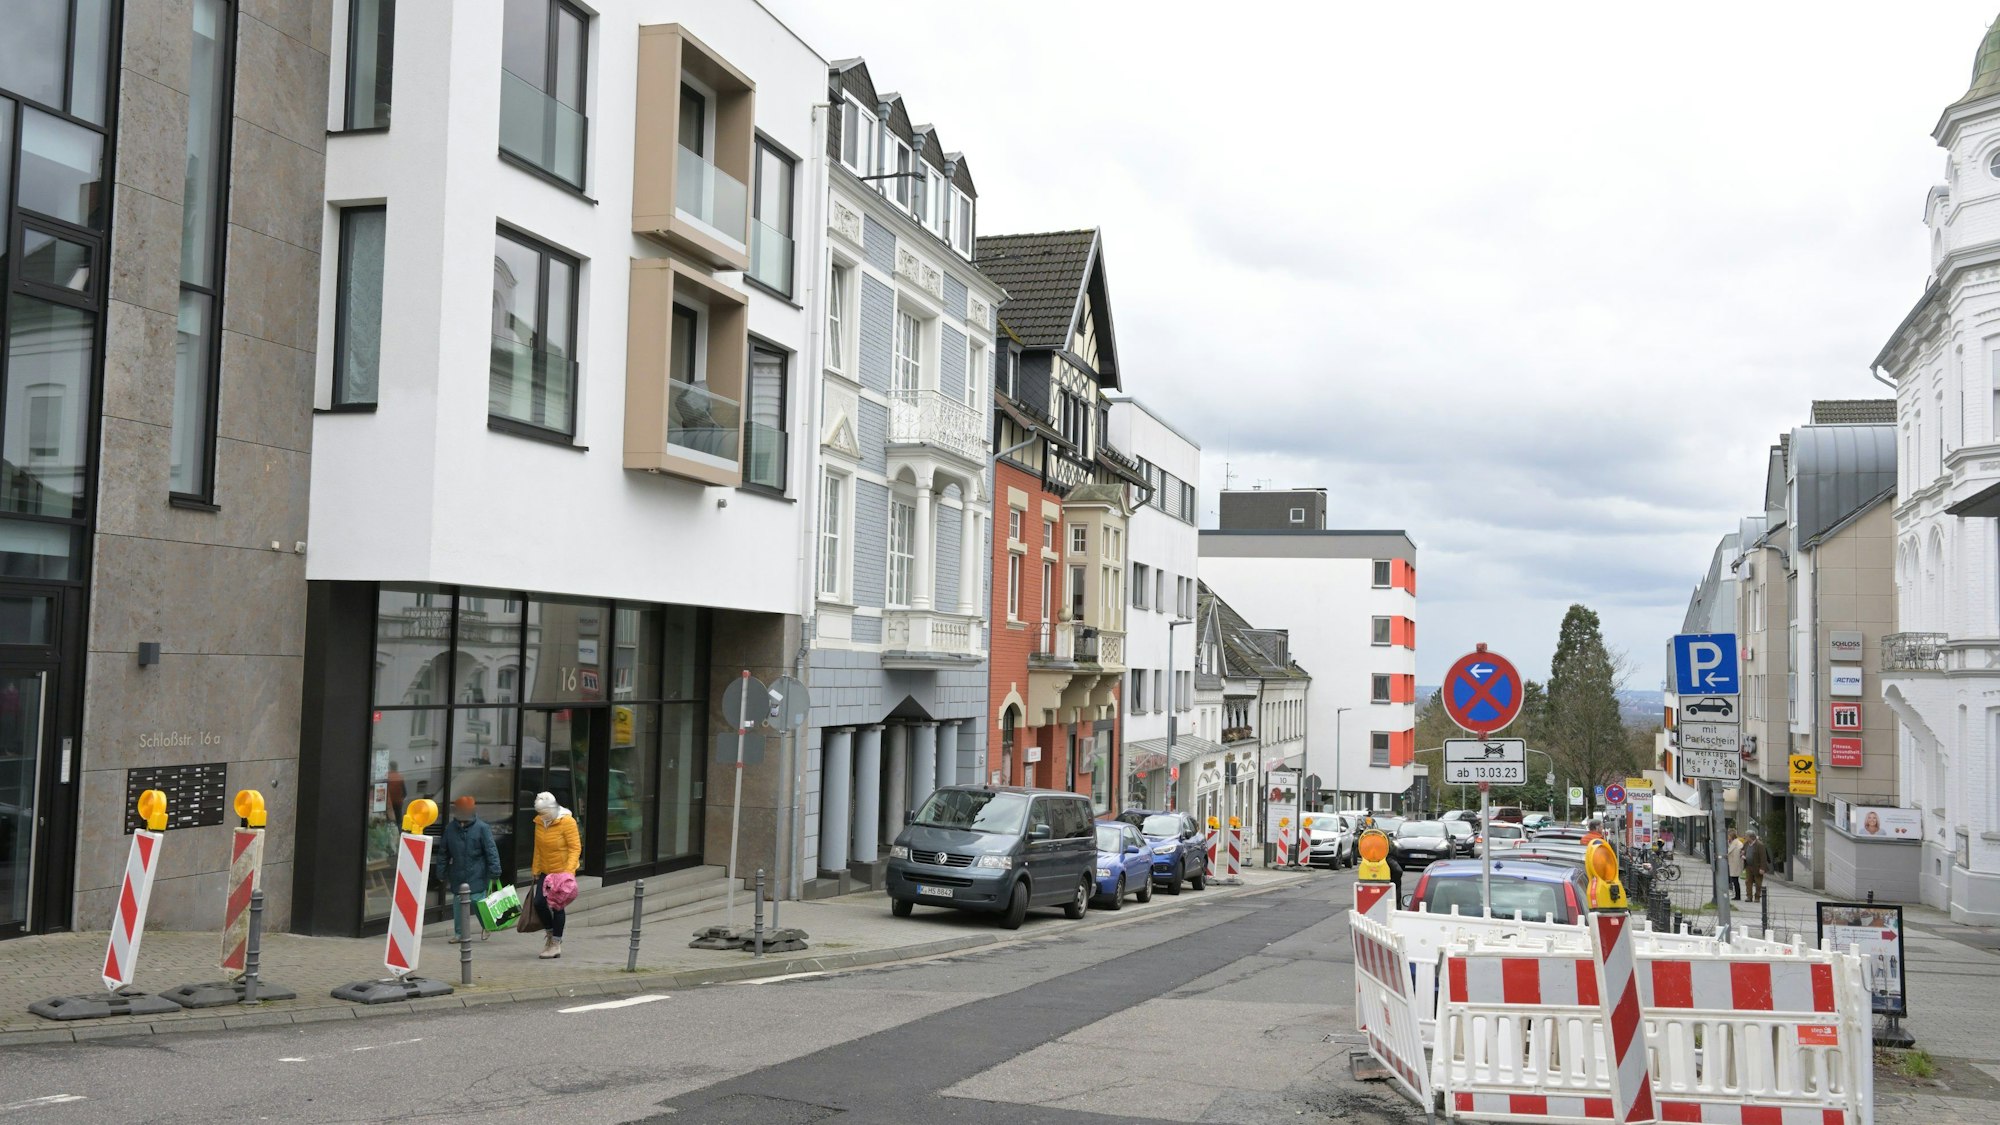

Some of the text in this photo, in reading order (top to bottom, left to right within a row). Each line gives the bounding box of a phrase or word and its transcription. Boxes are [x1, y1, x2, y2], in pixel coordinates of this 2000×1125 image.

[1689, 641, 1722, 687] P
[561, 667, 577, 691] 16
[1835, 711, 1856, 725] fit
[140, 731, 221, 748] Schloßstr. 16 a
[1685, 734, 1735, 745] Parkschein
[1457, 767, 1517, 778] ab 13.03.23
[937, 888, 952, 896] 8842
